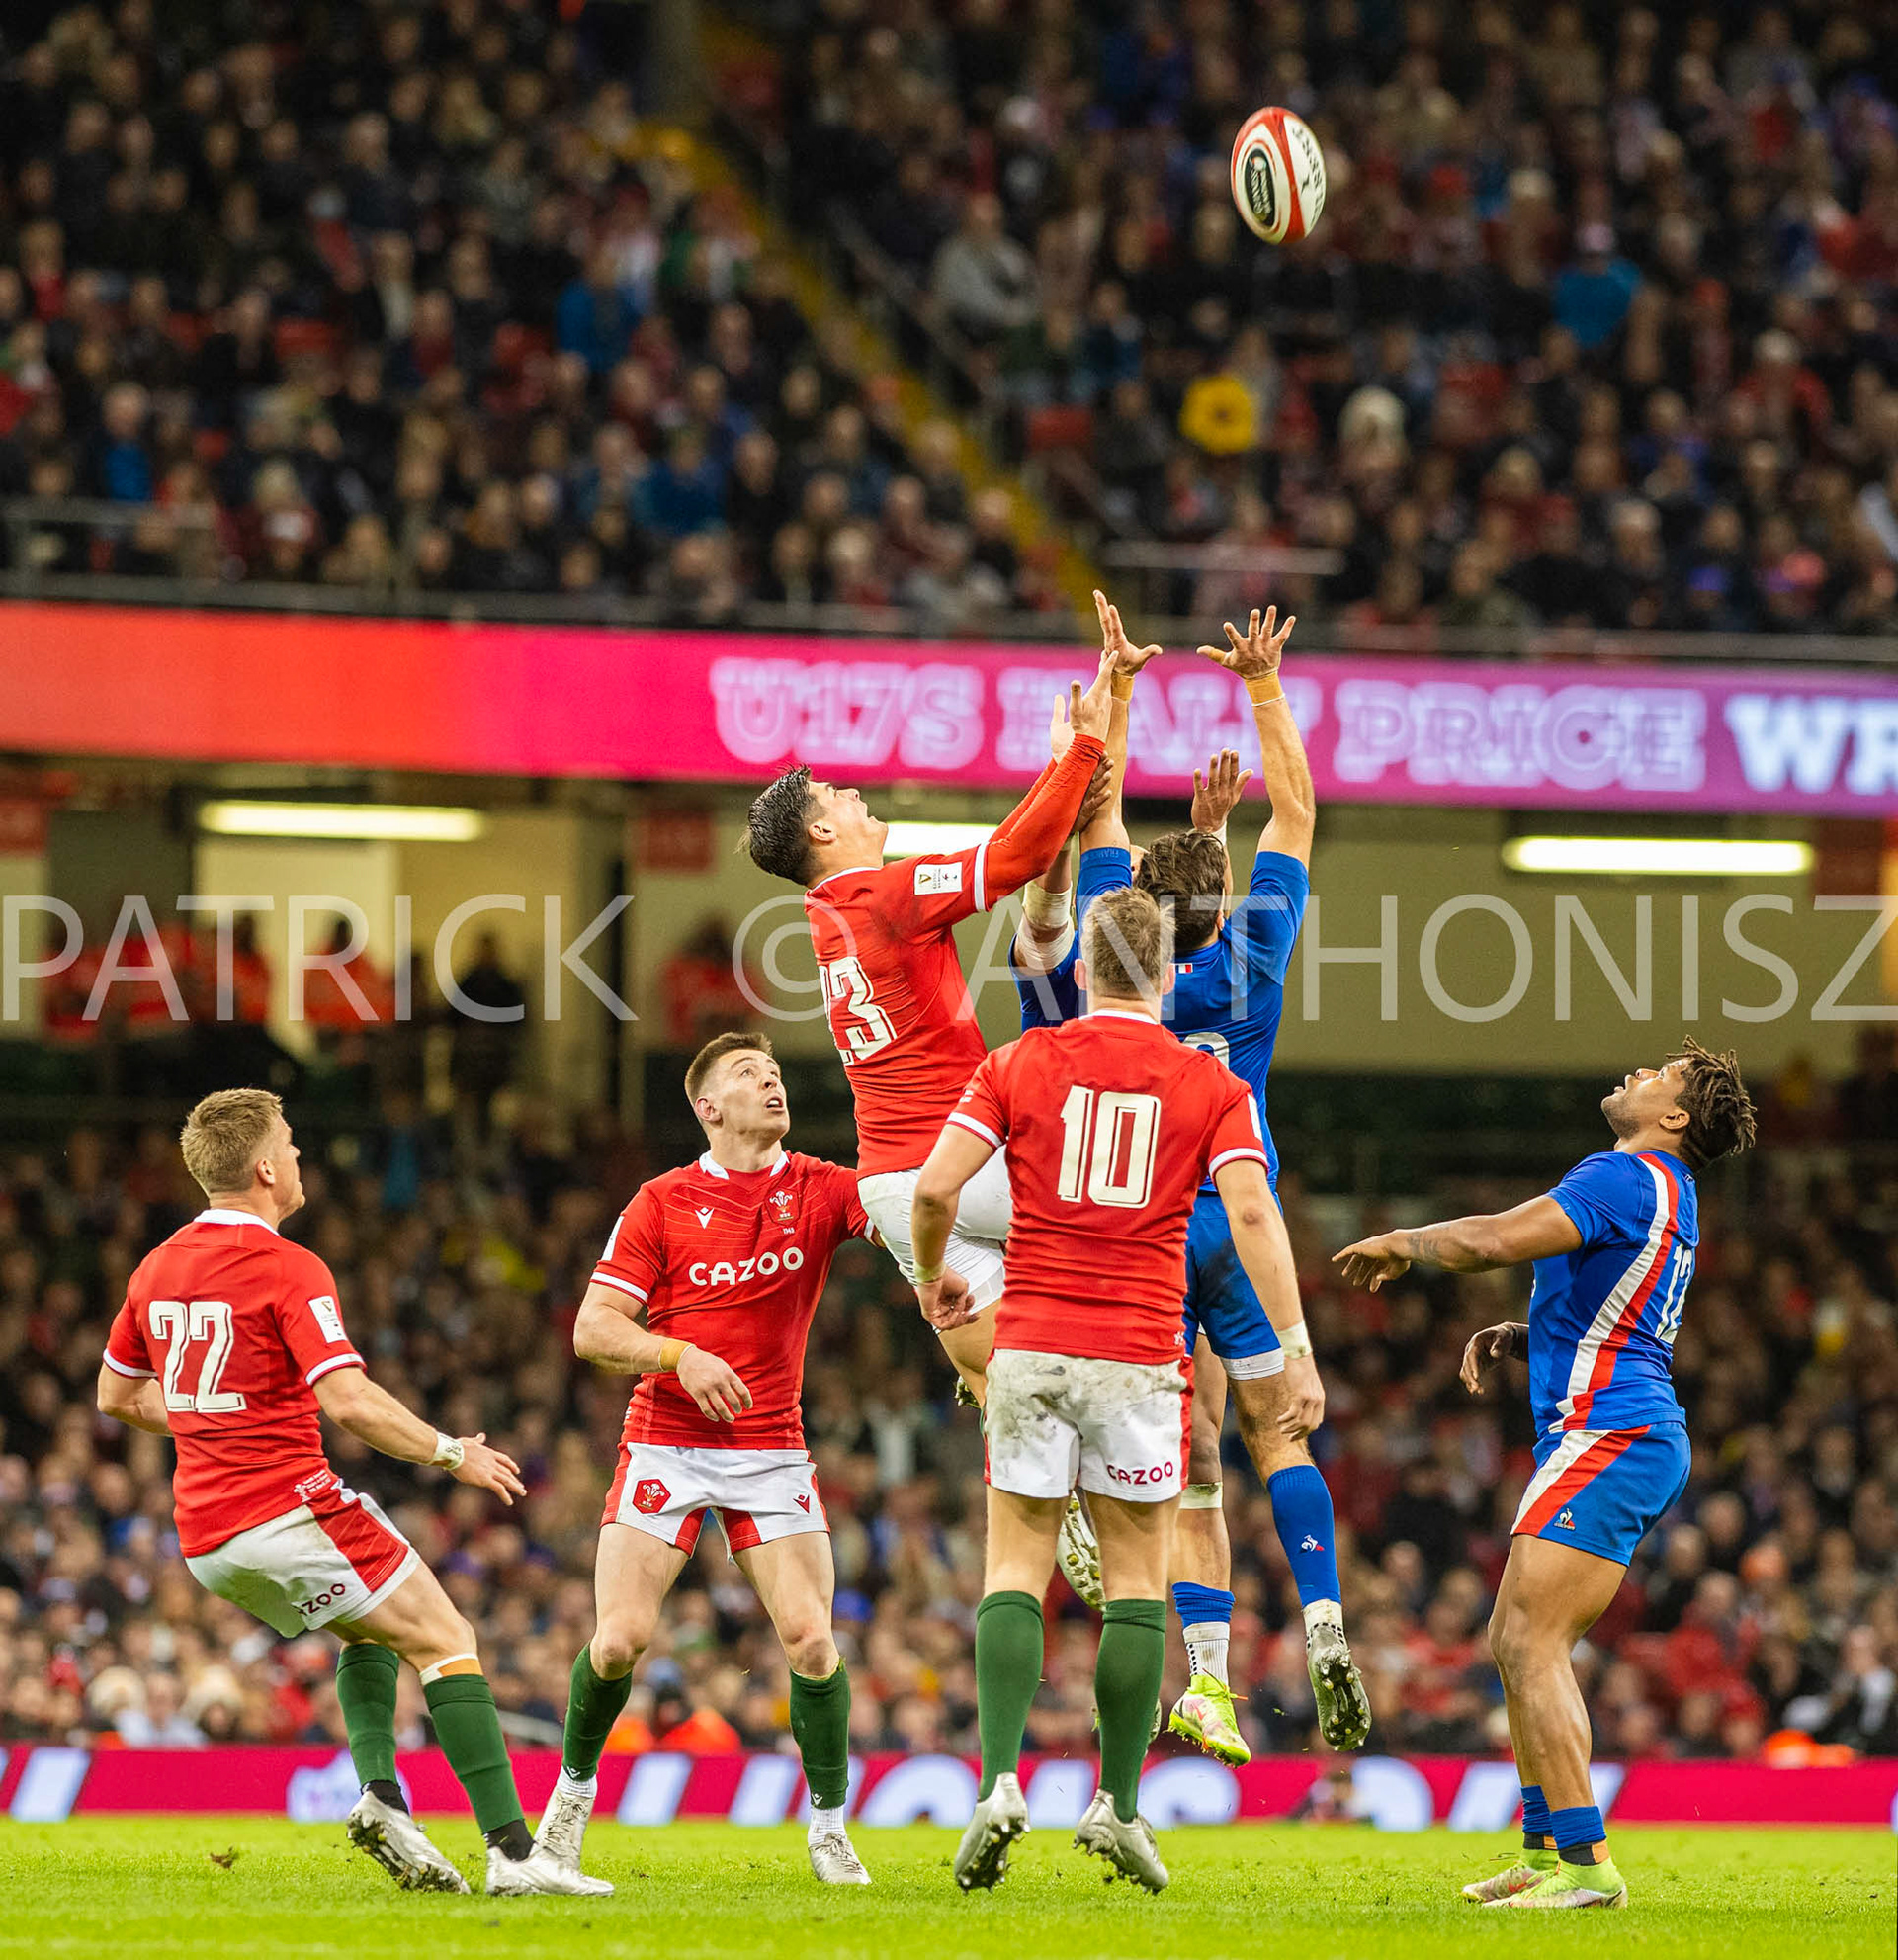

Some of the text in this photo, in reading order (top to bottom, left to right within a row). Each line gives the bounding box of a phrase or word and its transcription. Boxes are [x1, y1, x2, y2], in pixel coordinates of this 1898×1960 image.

[709, 656, 986, 769] U17S
[1334, 679, 1706, 791] PRICE
[1057, 1084, 1162, 1209] 10
[688, 1246, 805, 1286] CAZOO
[148, 1300, 248, 1414] 22
[1106, 1461, 1173, 1486] CAZOO
[298, 1583, 346, 1616] ZOO
